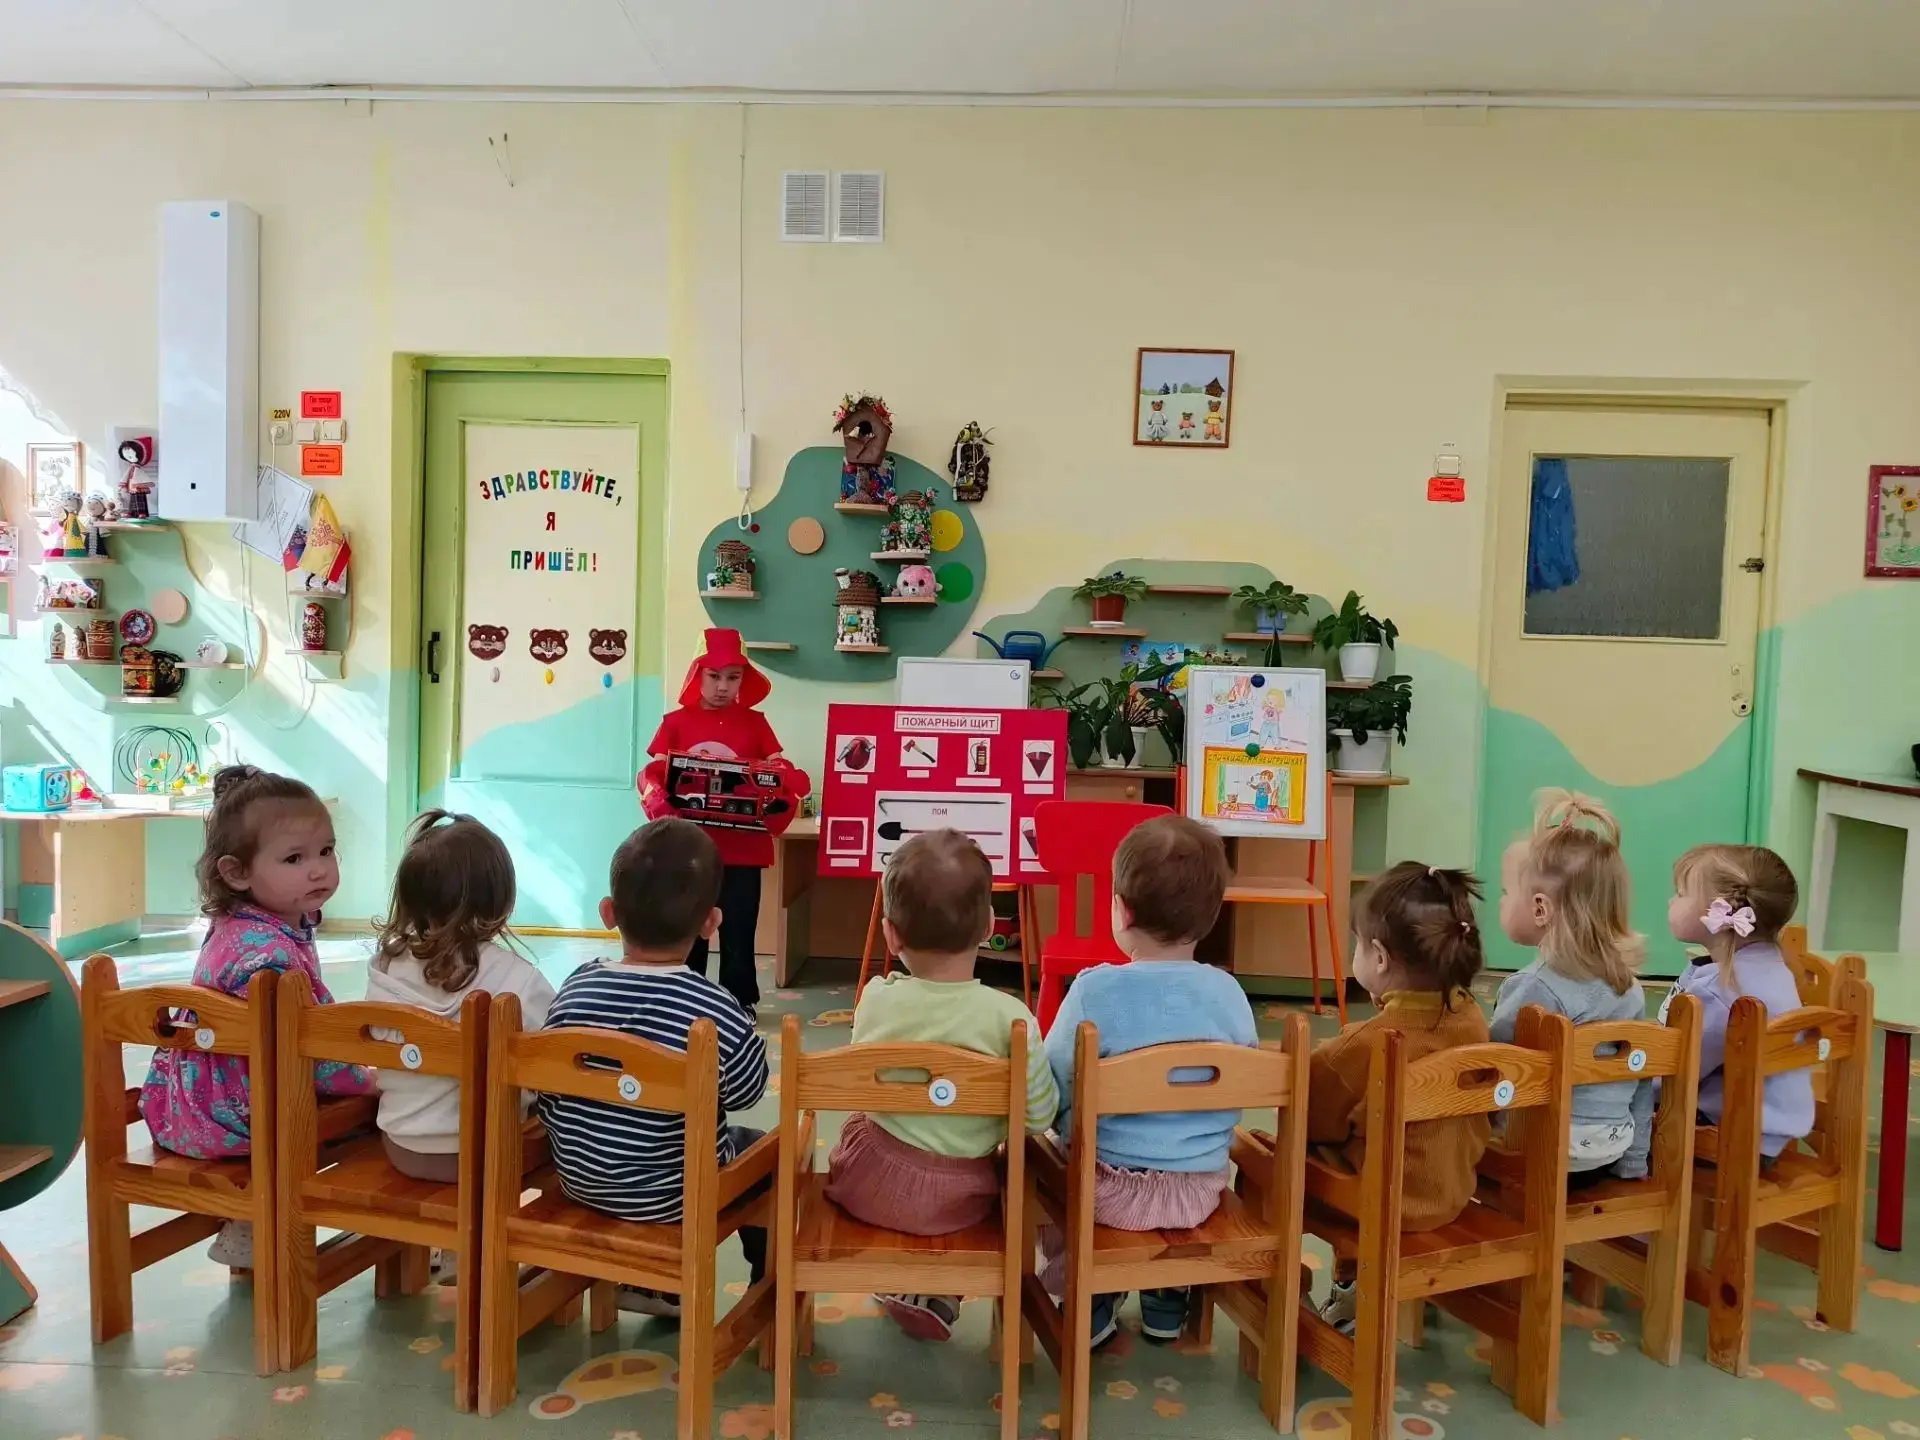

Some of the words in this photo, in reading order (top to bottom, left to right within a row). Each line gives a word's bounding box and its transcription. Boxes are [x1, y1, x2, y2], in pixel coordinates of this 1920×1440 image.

[273, 409, 291, 419] 220V
[479, 467, 622, 506] ЗДРАВСТВУЙТЕ,
[546, 511, 556, 531] Я
[511, 547, 597, 572] ПРИШЁЛ!
[902, 716, 967, 728] ПОЖАРНЫЙ
[970, 719, 995, 730] ЩИТ
[932, 807, 948, 816] ЛОМ
